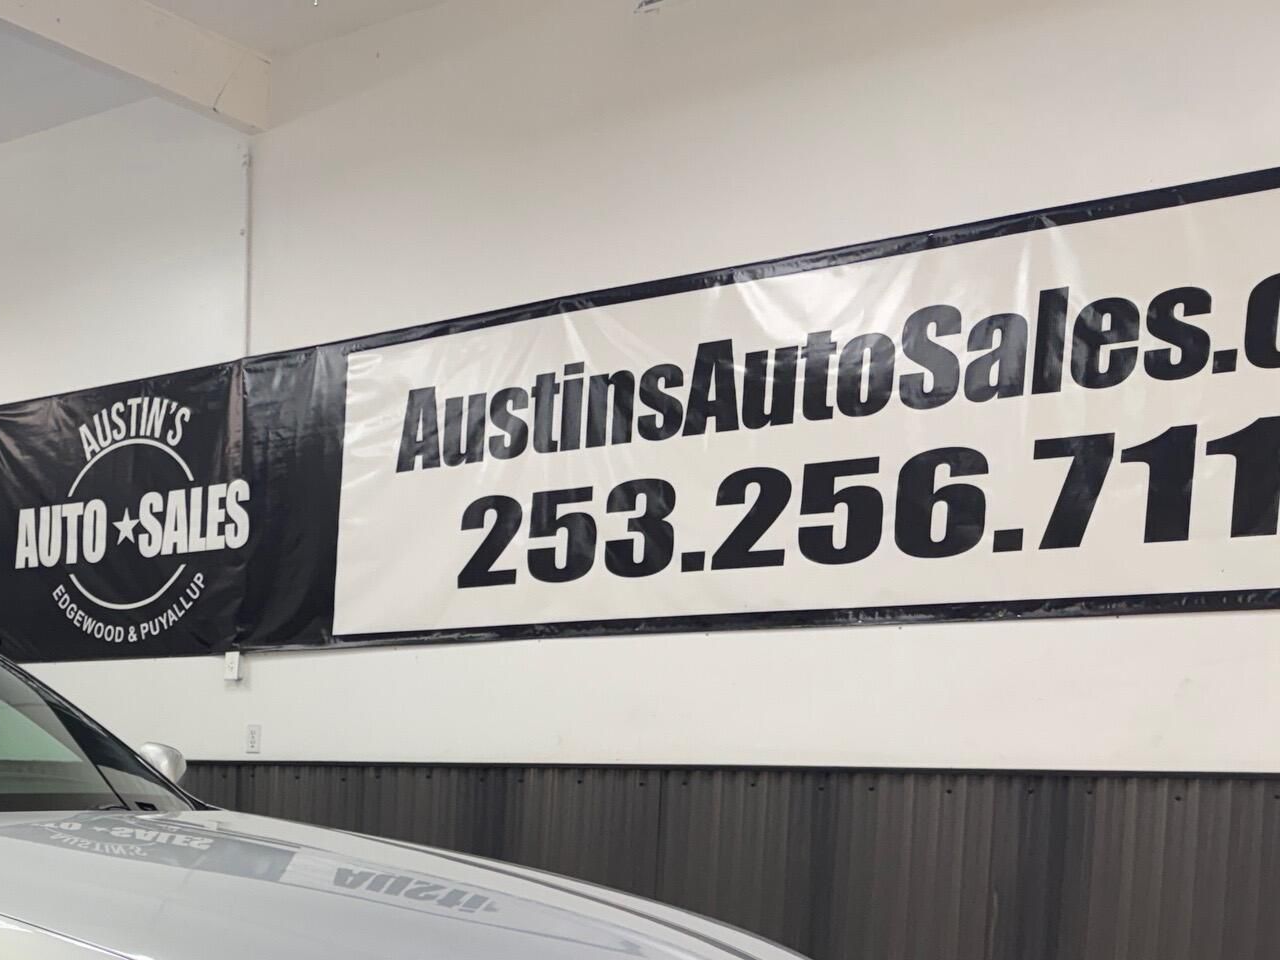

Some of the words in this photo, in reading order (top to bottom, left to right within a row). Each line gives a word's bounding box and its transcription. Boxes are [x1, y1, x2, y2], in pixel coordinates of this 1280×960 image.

[78, 396, 190, 461] AUSTIN'S
[15, 499, 107, 569] AUTO
[138, 479, 250, 558] SALES
[52, 584, 124, 643] EDGEWOOD
[127, 626, 137, 642] &
[140, 572, 205, 640] PUYALLUP
